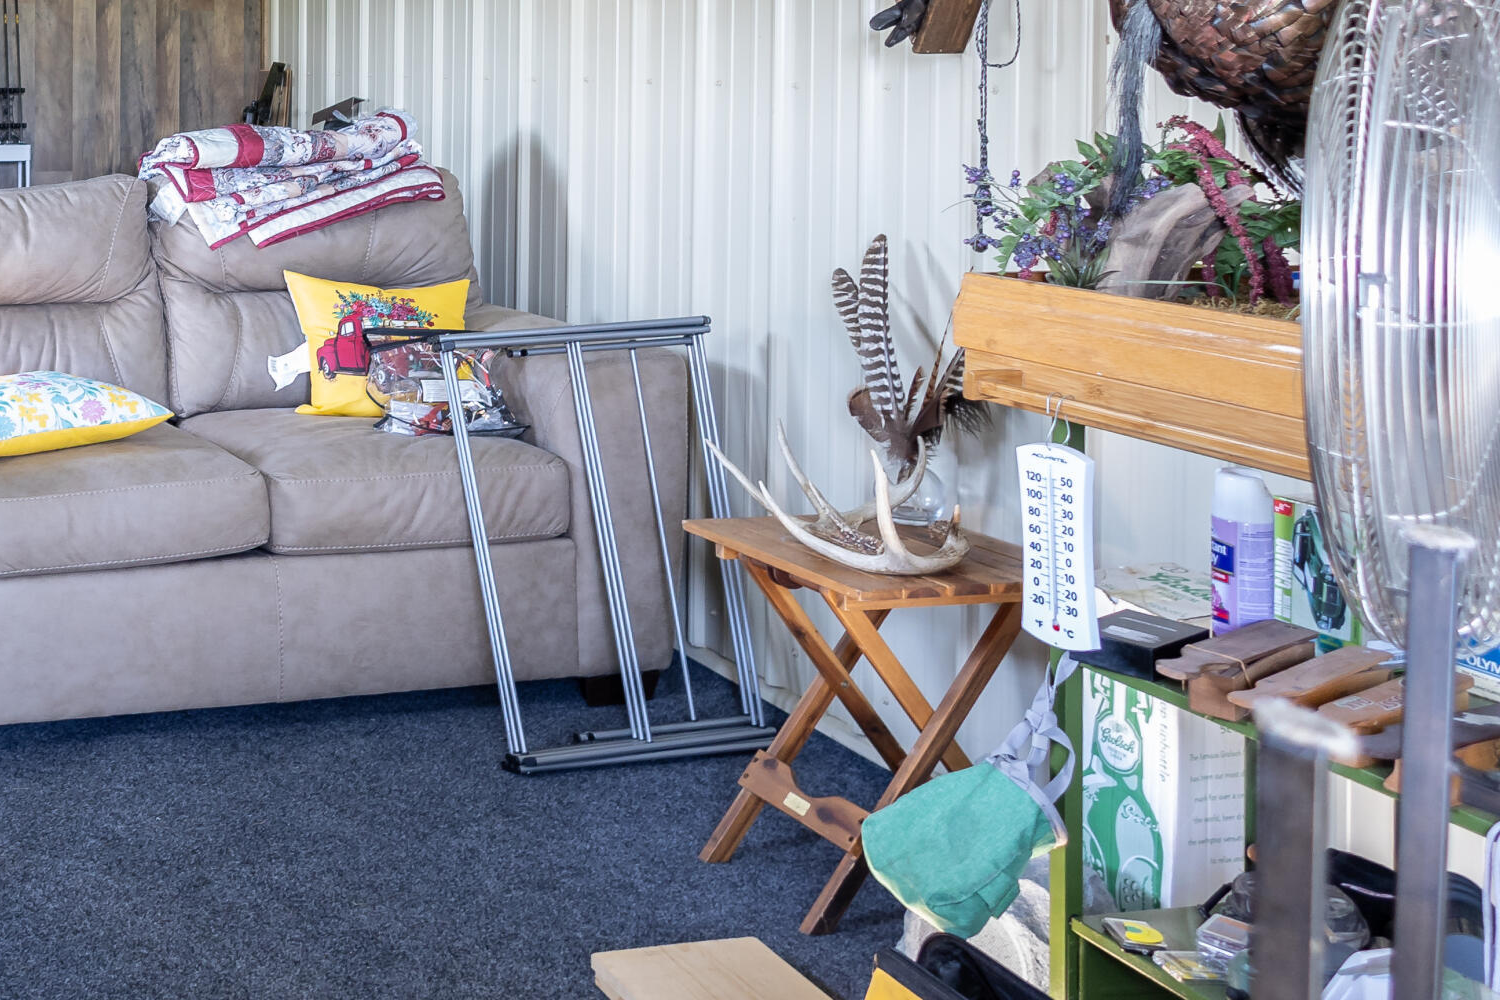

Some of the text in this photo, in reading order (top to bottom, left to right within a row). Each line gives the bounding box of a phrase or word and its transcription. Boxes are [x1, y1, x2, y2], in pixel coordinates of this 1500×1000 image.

[1025, 470, 1042, 483] 120
[1060, 477, 1073, 488] 50
[1026, 488, 1043, 500] 100
[1060, 493, 1073, 504] 40
[1028, 506, 1041, 517] 80
[1061, 509, 1074, 521] 30
[1028, 523, 1041, 535] 60
[1061, 525, 1074, 536] 20
[1029, 541, 1042, 552] 40
[1063, 541, 1074, 553] 10
[1030, 558, 1042, 569] 20
[1065, 558, 1072, 568] 0
[1033, 576, 1040, 586] 0
[1100, 726, 1135, 755] Grolsch
